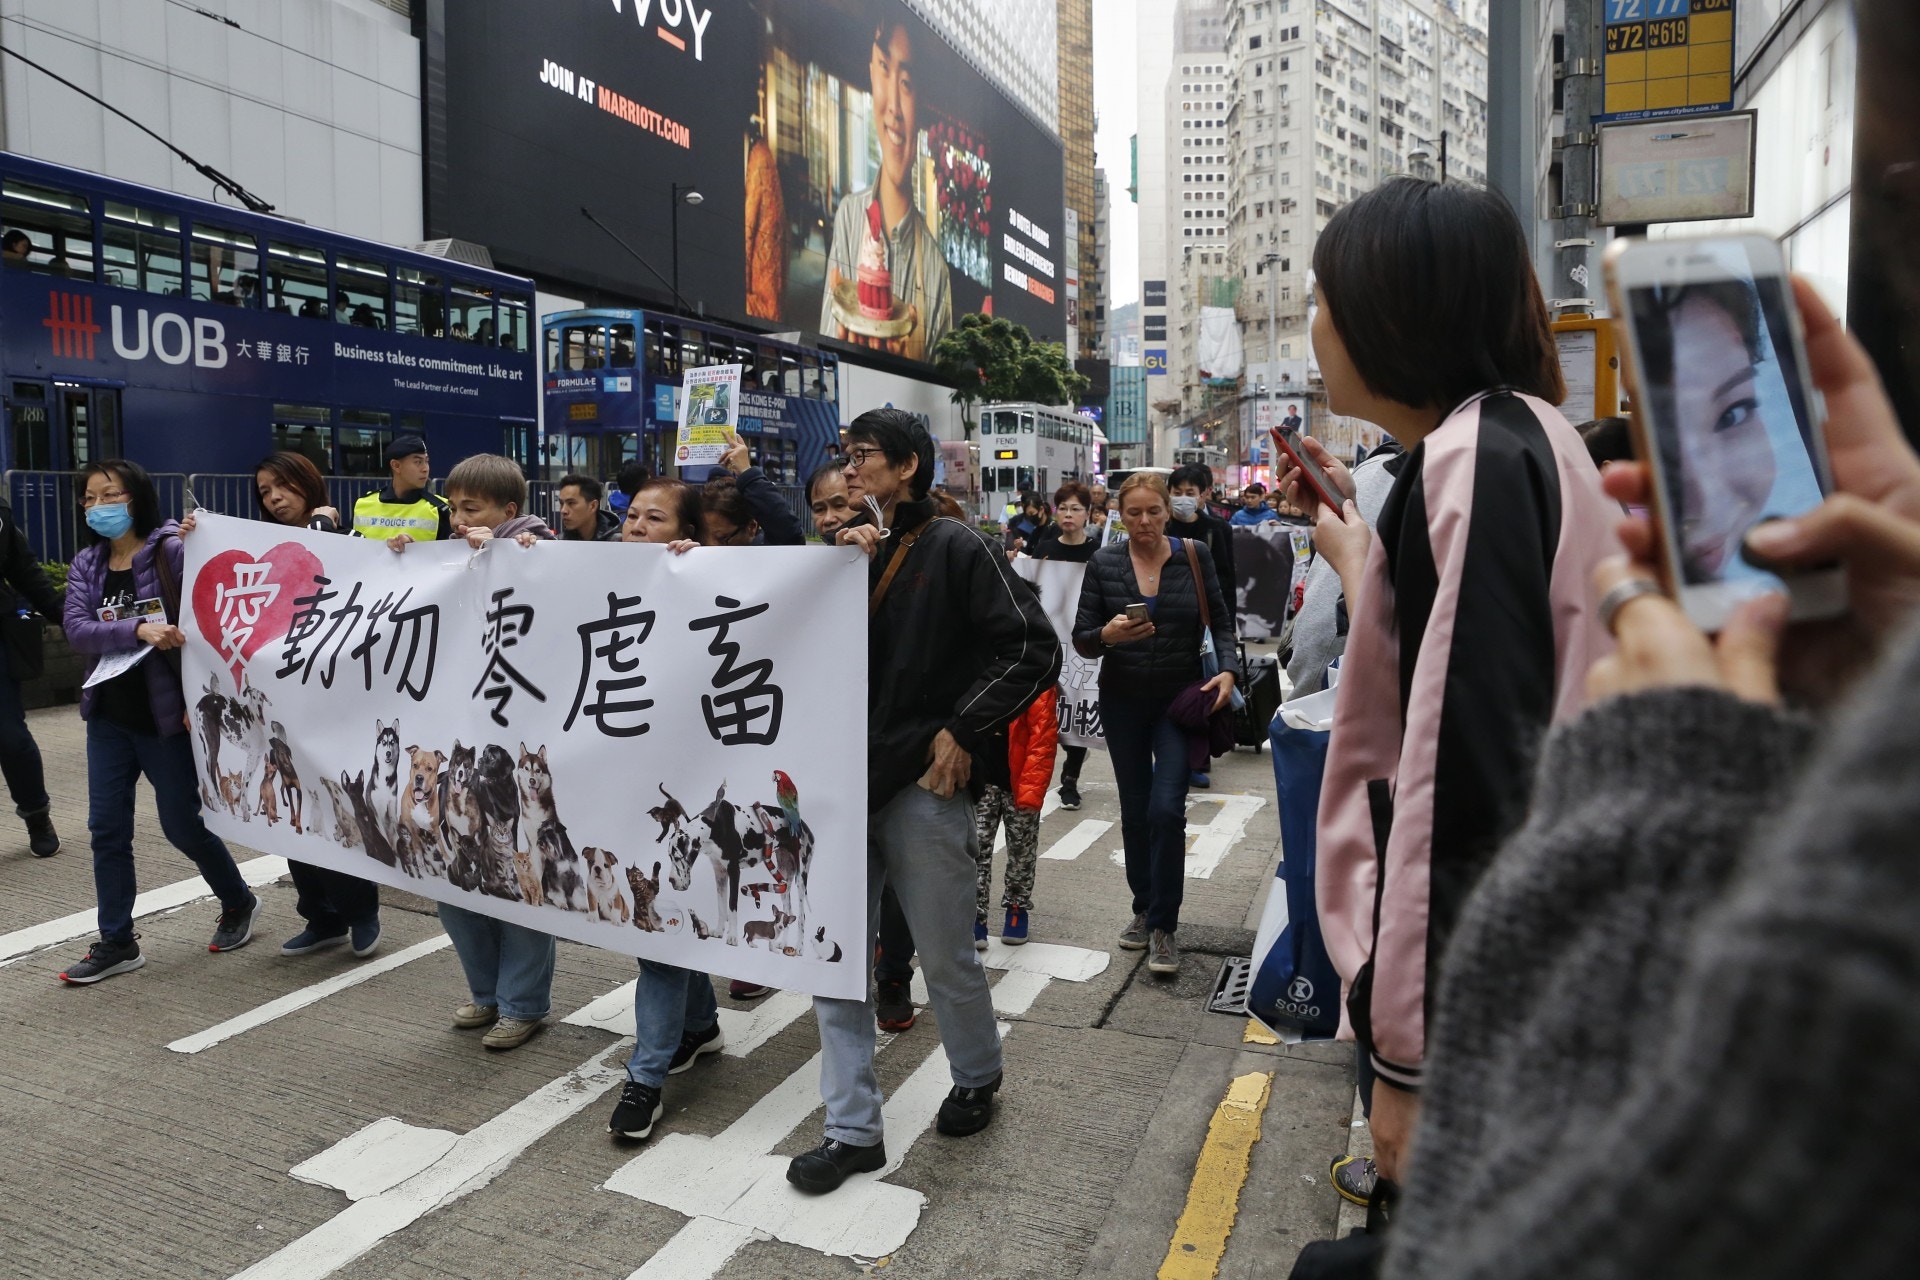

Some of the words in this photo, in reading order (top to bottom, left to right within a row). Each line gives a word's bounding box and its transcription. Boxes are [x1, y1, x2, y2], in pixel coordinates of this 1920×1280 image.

[1613, 0, 1640, 19] 72
[1655, 0, 1681, 14] 77
[612, 0, 712, 61] VOY
[539, 58, 574, 95] JOIN
[577, 76, 595, 104] AT
[598, 85, 690, 149] MARRIOTT.COM
[1652, 104, 1720, 117] www.citybus.com.hk
[1016, 212, 1032, 237] HOTEL
[1032, 223, 1050, 249] BRANDS
[1004, 233, 1026, 261] ENDLESS
[1025, 247, 1055, 278] EXPERIENCES
[1004, 263, 1028, 291] REWARDS
[111, 304, 228, 369] UOB
[236, 339, 310, 366] 大華銀行
[334, 342, 384, 363] Business
[386, 350, 416, 367] takes
[418, 357, 486, 377] commitment.
[488, 364, 507, 379] Like
[509, 369, 523, 381] art
[394, 378, 406, 388] The
[406, 379, 420, 390] Lead
[421, 381, 441, 392] Partner
[442, 384, 449, 393] of
[449, 386, 459, 394] Art
[460, 386, 479, 396] Central
[739, 392, 750, 405] ONG
[751, 393, 768, 408] KONG
[380, 518, 407, 527] POLICE
[1275, 998, 1320, 1017] SOGO
